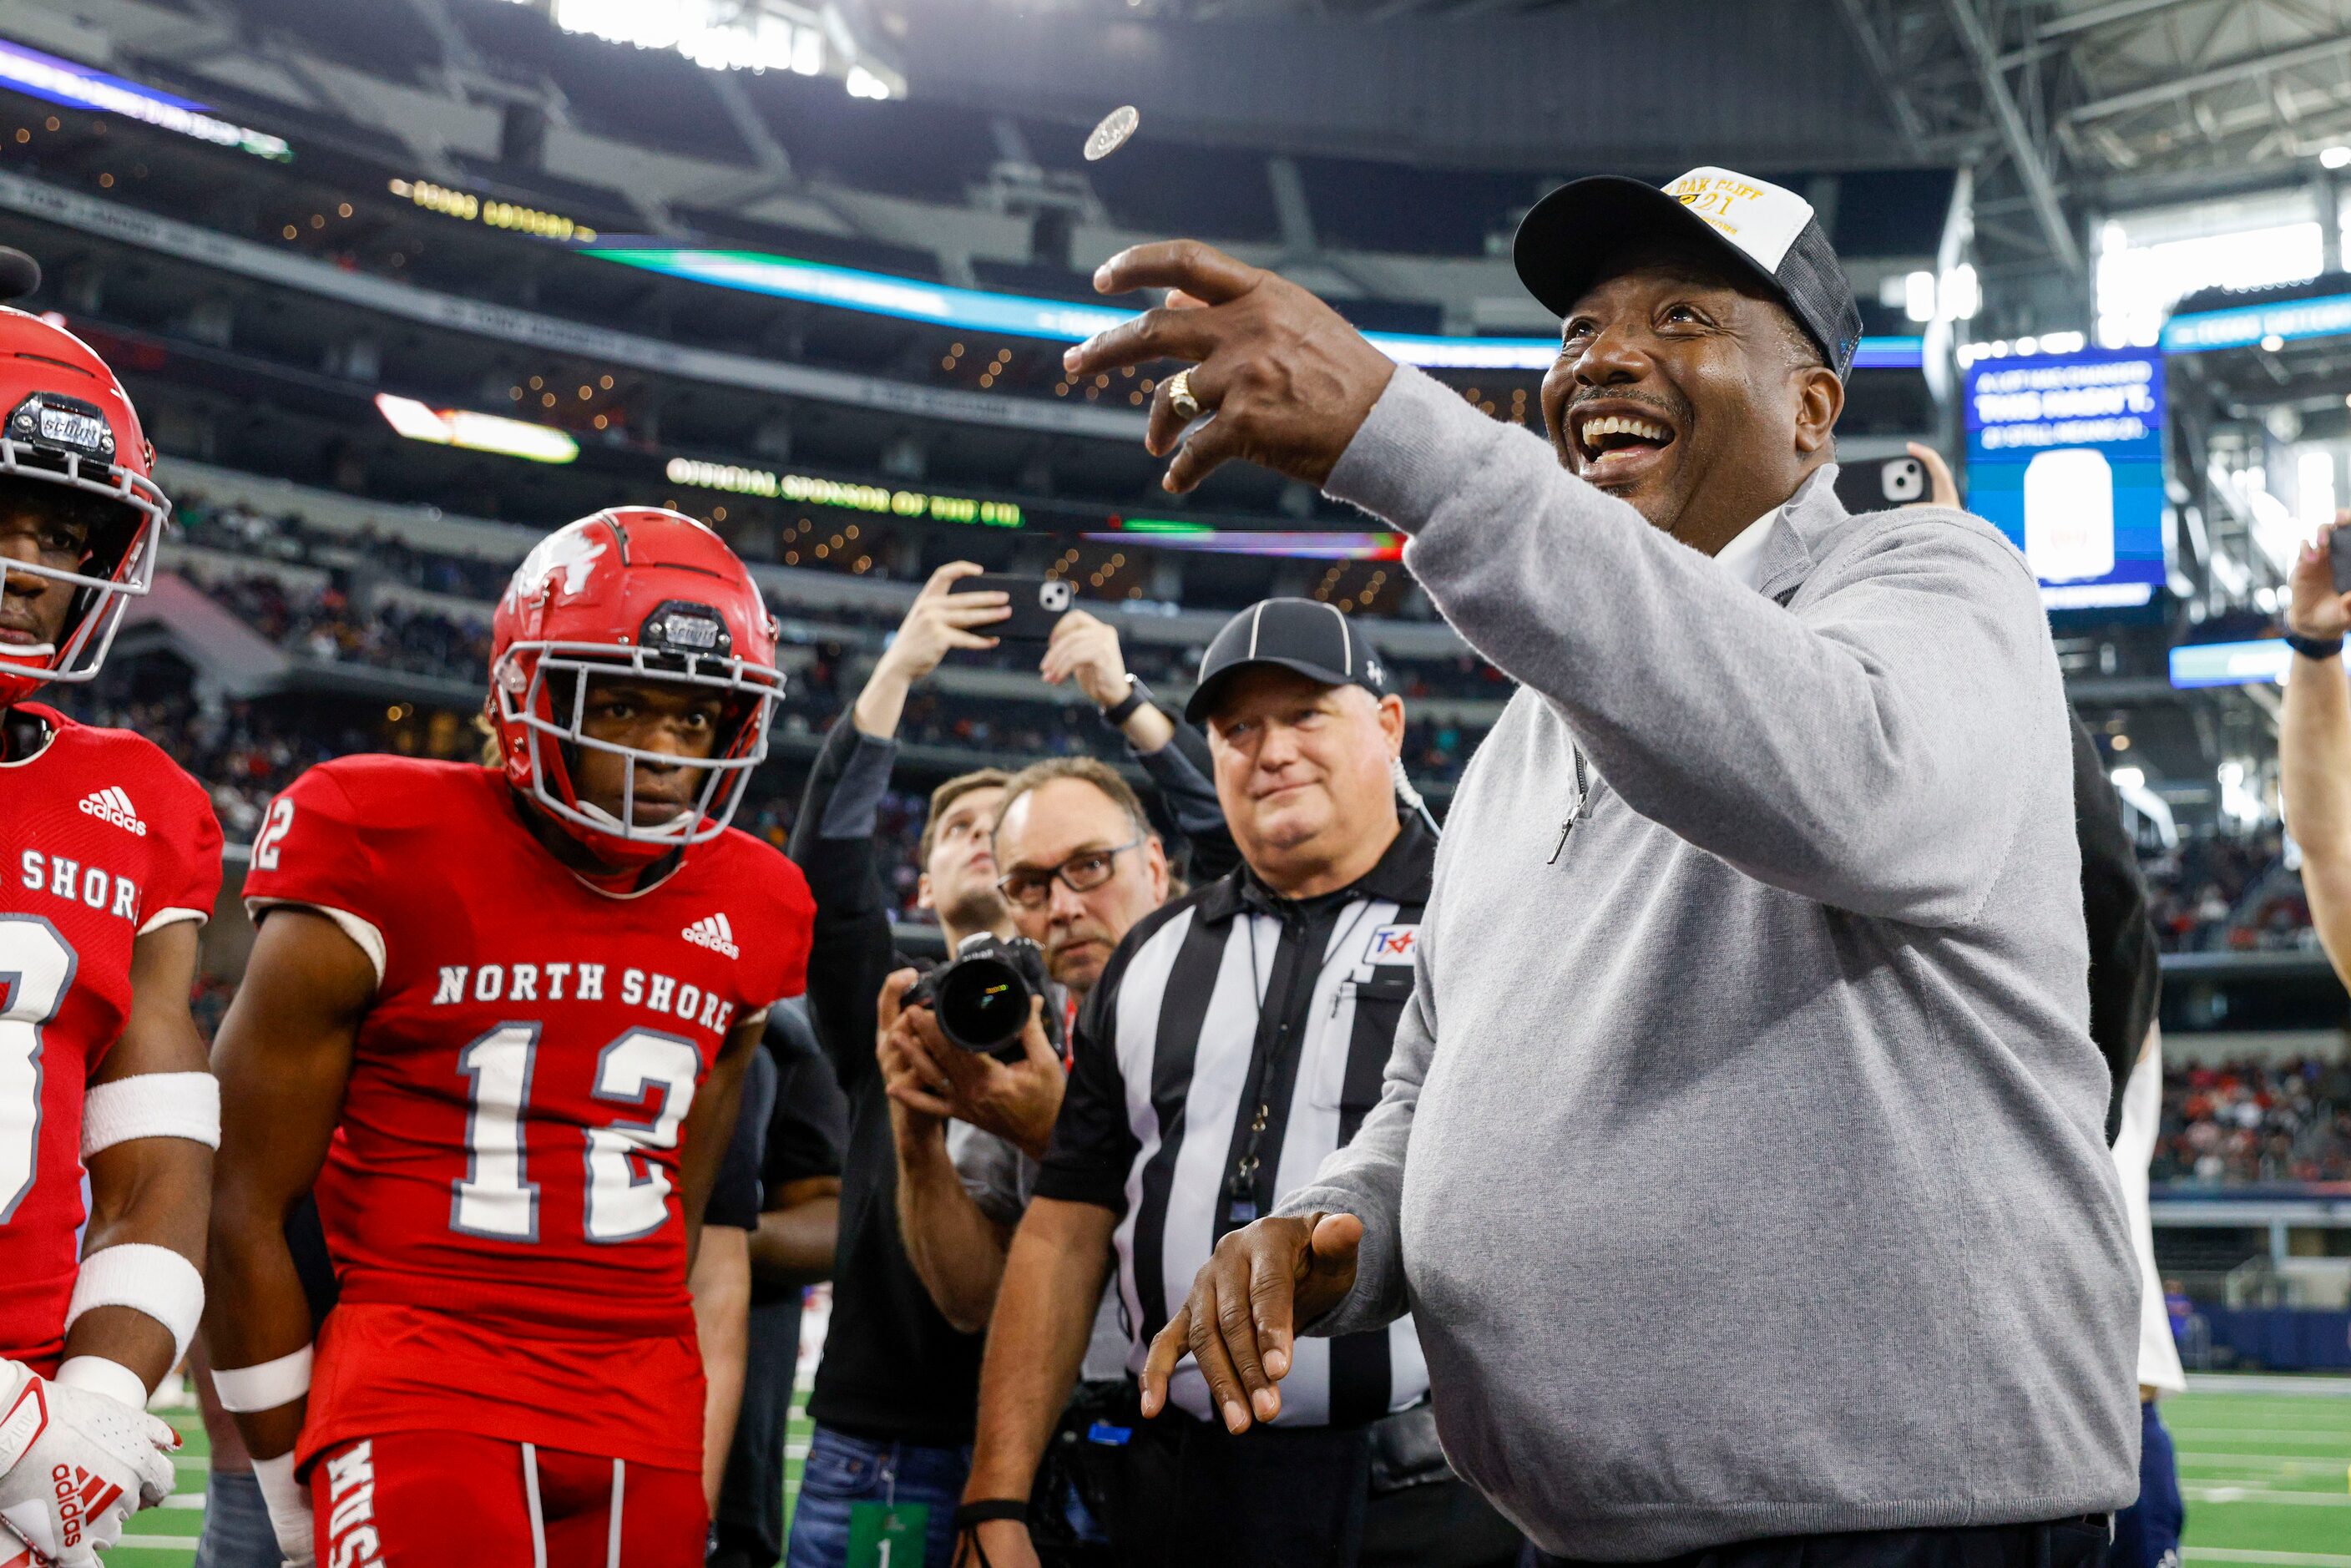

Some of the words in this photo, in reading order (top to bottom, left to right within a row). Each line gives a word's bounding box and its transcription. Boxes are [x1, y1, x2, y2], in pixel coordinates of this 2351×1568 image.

[1676, 178, 1711, 195] OAK
[1714, 179, 1764, 201] CLIFF
[78, 799, 147, 837] adidas
[250, 796, 296, 872] 12
[21, 848, 142, 928] SHOR
[681, 927, 740, 960] adidas
[432, 962, 607, 1004] NORTH
[620, 968, 736, 1037] SHORE
[449, 1020, 704, 1244] 12
[52, 1463, 85, 1547] adidas
[326, 1437, 386, 1568] MUS
